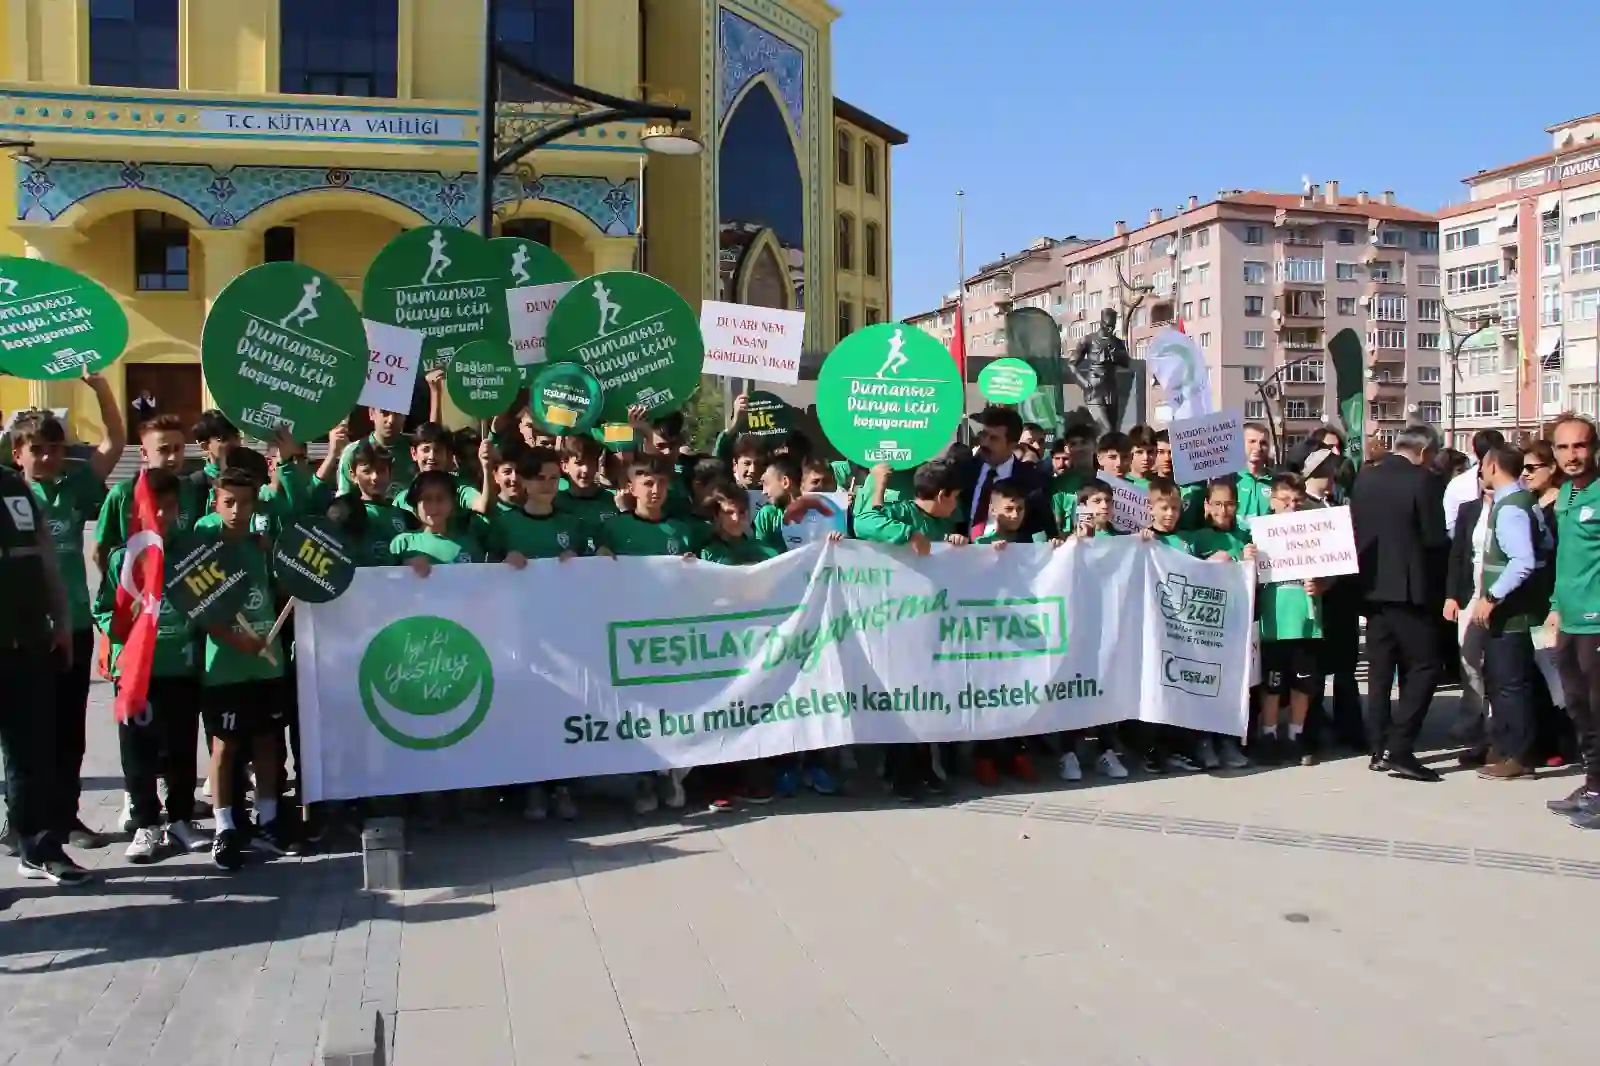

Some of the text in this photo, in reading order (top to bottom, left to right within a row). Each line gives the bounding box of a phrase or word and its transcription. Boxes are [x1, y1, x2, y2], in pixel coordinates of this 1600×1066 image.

[268, 113, 352, 133] KÜTAHYA
[396, 286, 487, 306] Dumansız
[395, 304, 451, 324] Dünya
[2, 319, 94, 350] koşuyorum!
[245, 319, 338, 367] Dumansız
[580, 321, 665, 363] Dumansız
[237, 337, 337, 388] Dünya için
[455, 361, 494, 375] Bağlan
[238, 361, 324, 403] koşuyorum!
[851, 380, 936, 398] Dumansız
[847, 396, 901, 414] Dünya
[747, 411, 777, 429] hiç
[853, 414, 929, 430] koşuyorum!
[298, 538, 334, 578] hiç
[184, 559, 227, 597] hiç
[939, 612, 1050, 643] HAFTASI
[220, 711, 238, 731] 11
[564, 713, 609, 744] Siz
[616, 709, 651, 741] de
[659, 708, 695, 738] bu
[862, 683, 951, 715] katılın,
[958, 680, 1041, 710] destek
[1045, 673, 1104, 703] verin.
